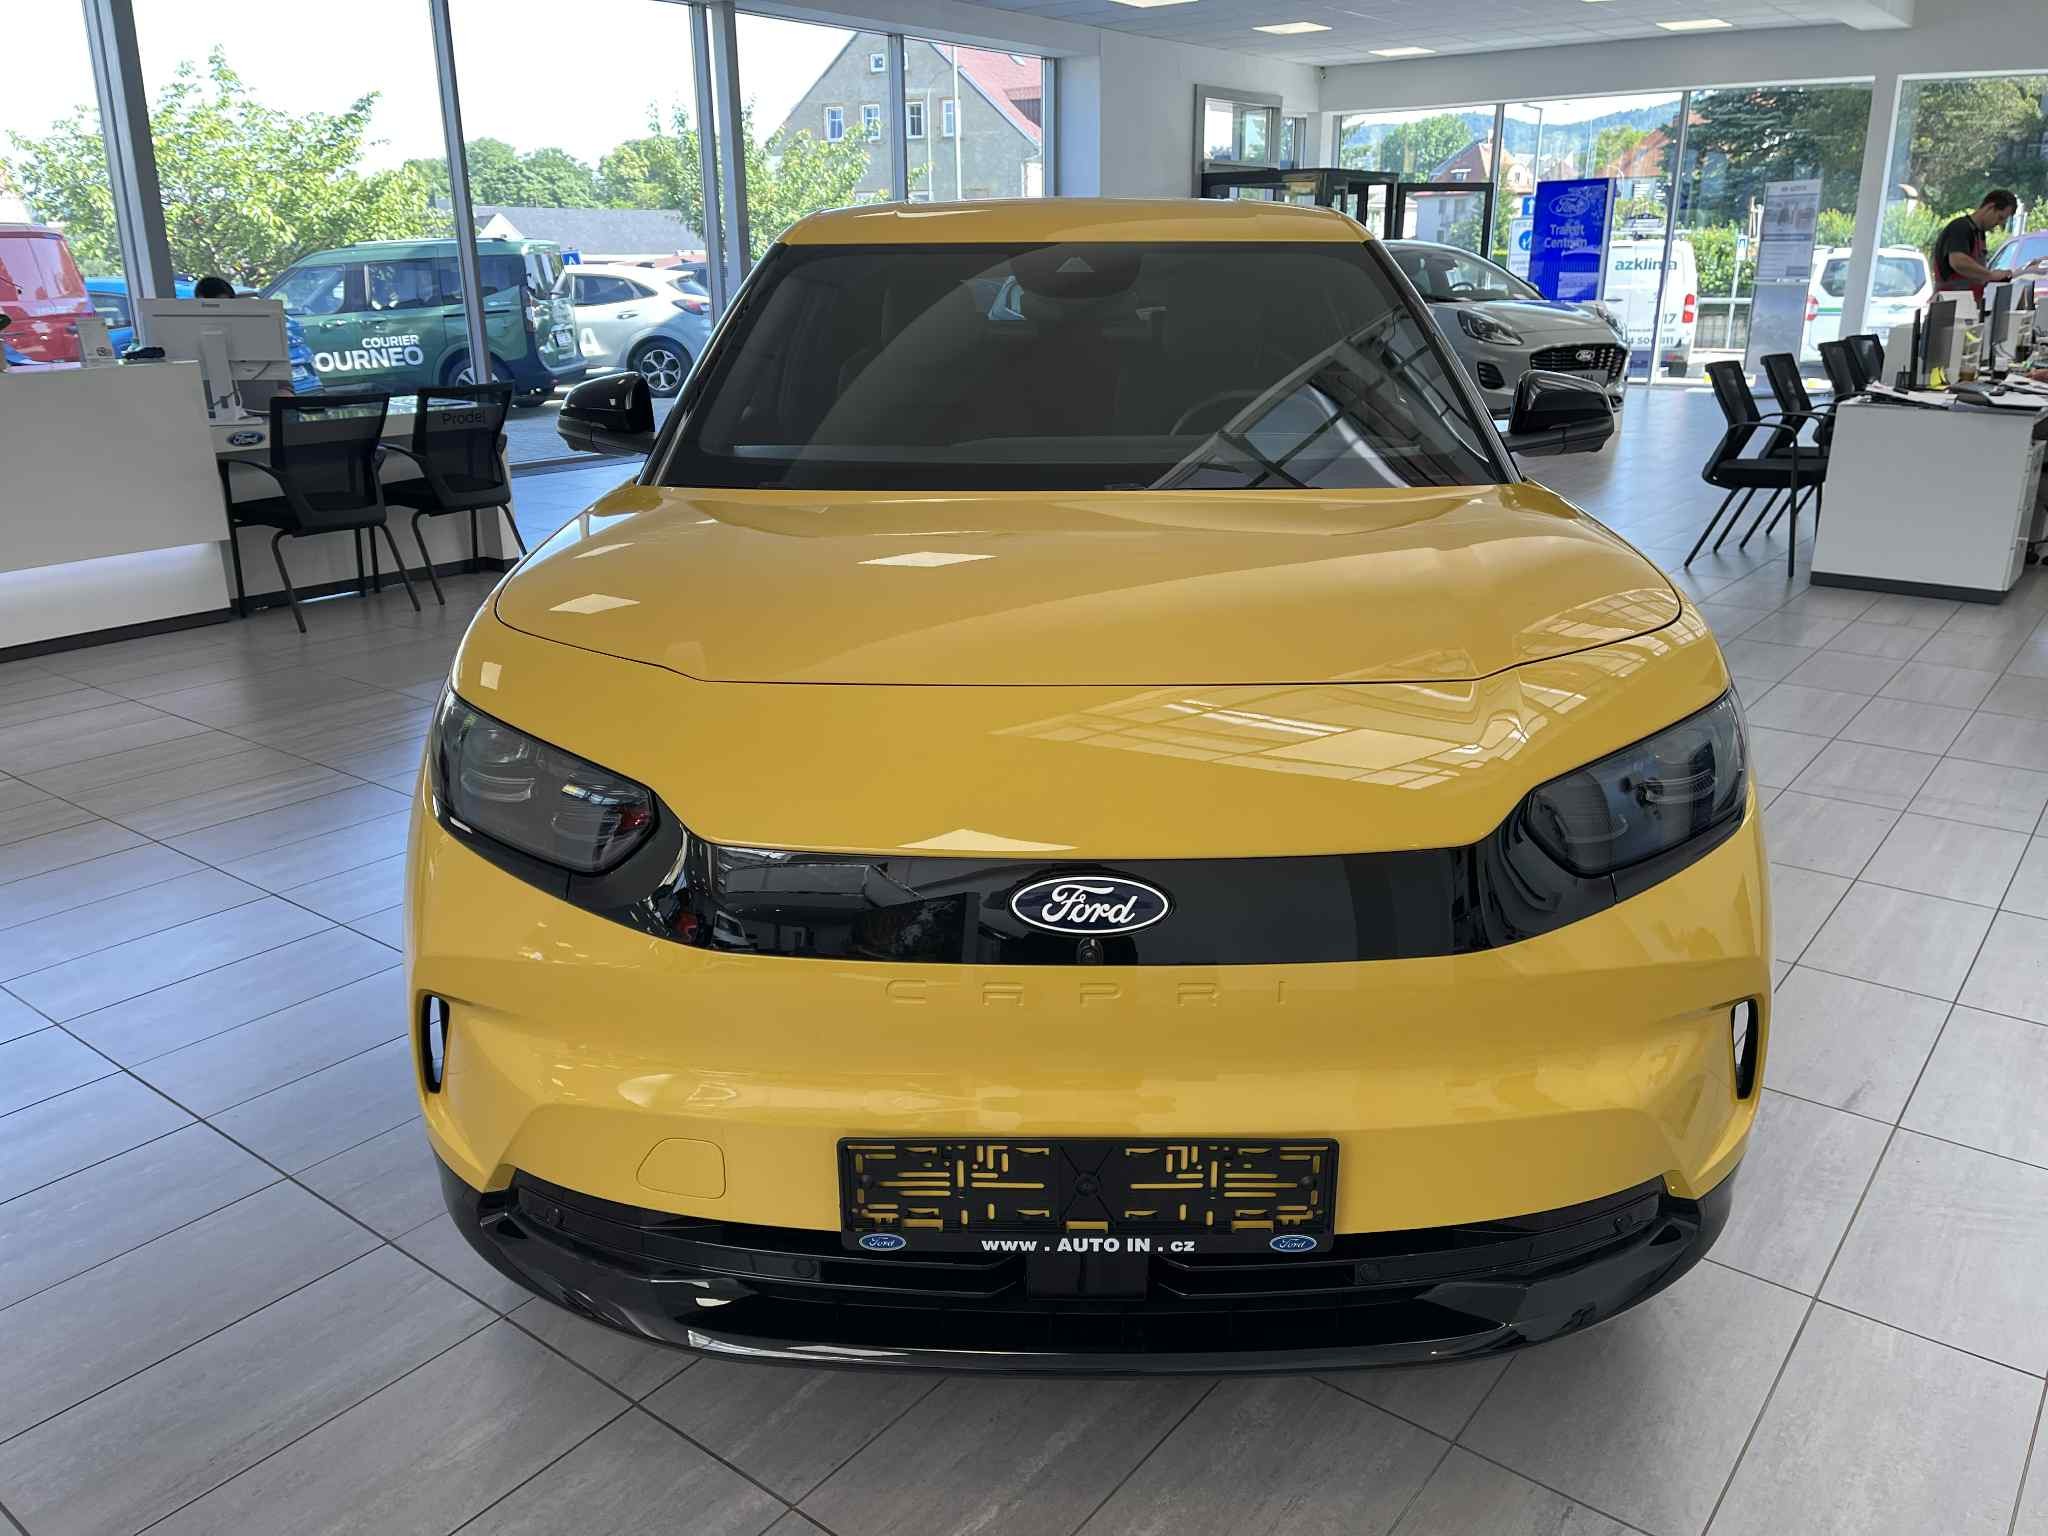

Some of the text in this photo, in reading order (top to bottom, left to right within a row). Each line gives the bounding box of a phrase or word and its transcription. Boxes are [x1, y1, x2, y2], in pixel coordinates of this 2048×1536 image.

[362, 334, 420, 349] COURIER
[312, 346, 424, 373] OURNEO
[884, 978, 1287, 1006] CAPRI
[1057, 1238, 1120, 1252] AUTO
[1127, 1238, 1150, 1252] IN
